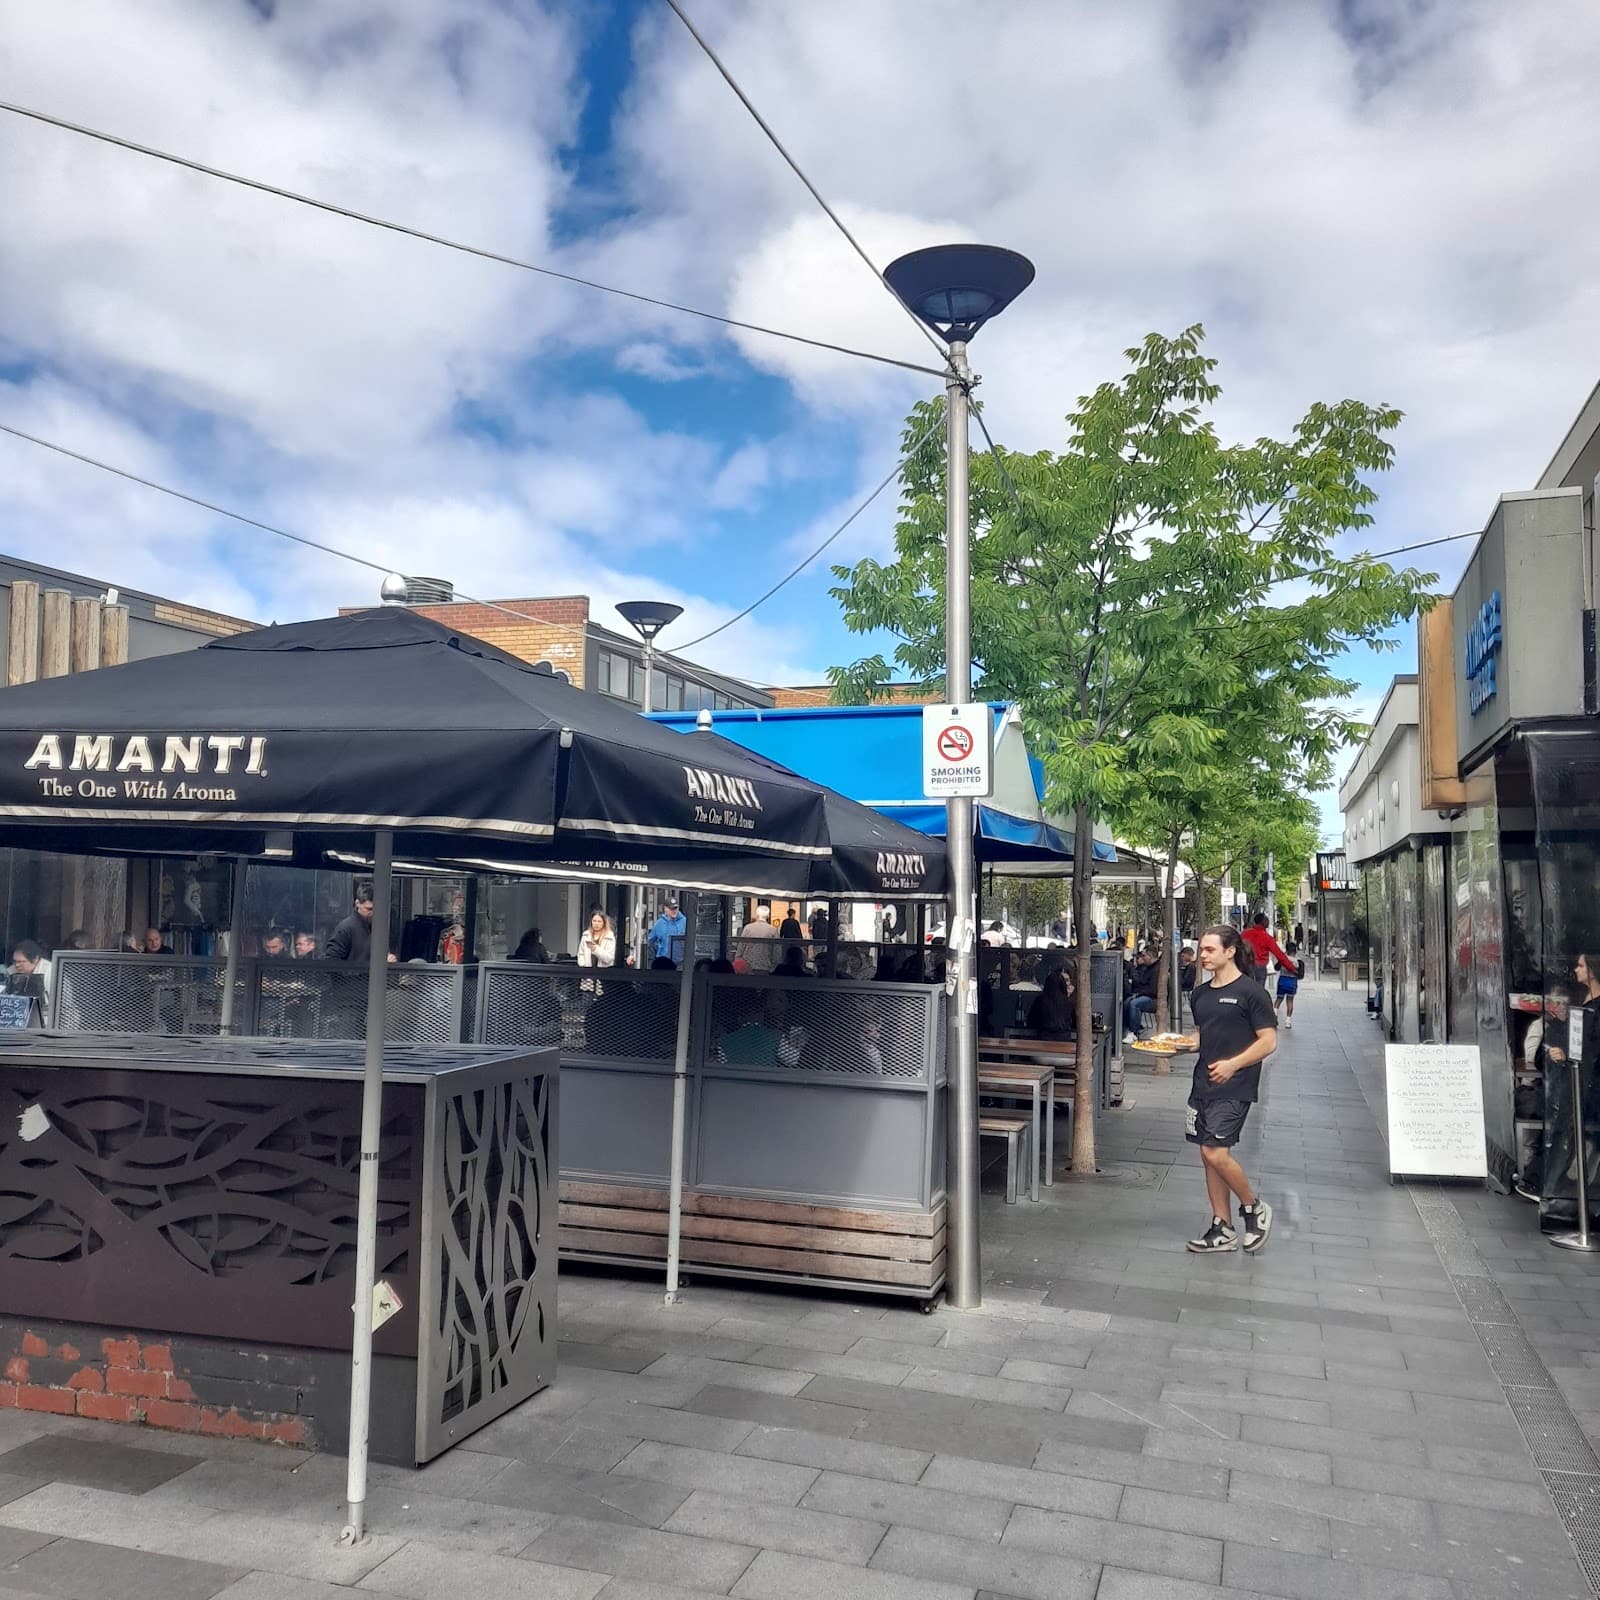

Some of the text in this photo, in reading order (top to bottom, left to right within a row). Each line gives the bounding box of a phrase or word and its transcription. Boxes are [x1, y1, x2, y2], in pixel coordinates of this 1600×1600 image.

[931, 766, 981, 776] SMOKING
[931, 775, 981, 784] PROHIBITED
[38, 778, 237, 801] The One With Aroma
[694, 805, 708, 823] The
[708, 808, 722, 825] One
[723, 810, 738, 827] With
[612, 860, 648, 872] Aroma
[1321, 880, 1347, 890] MEAT
